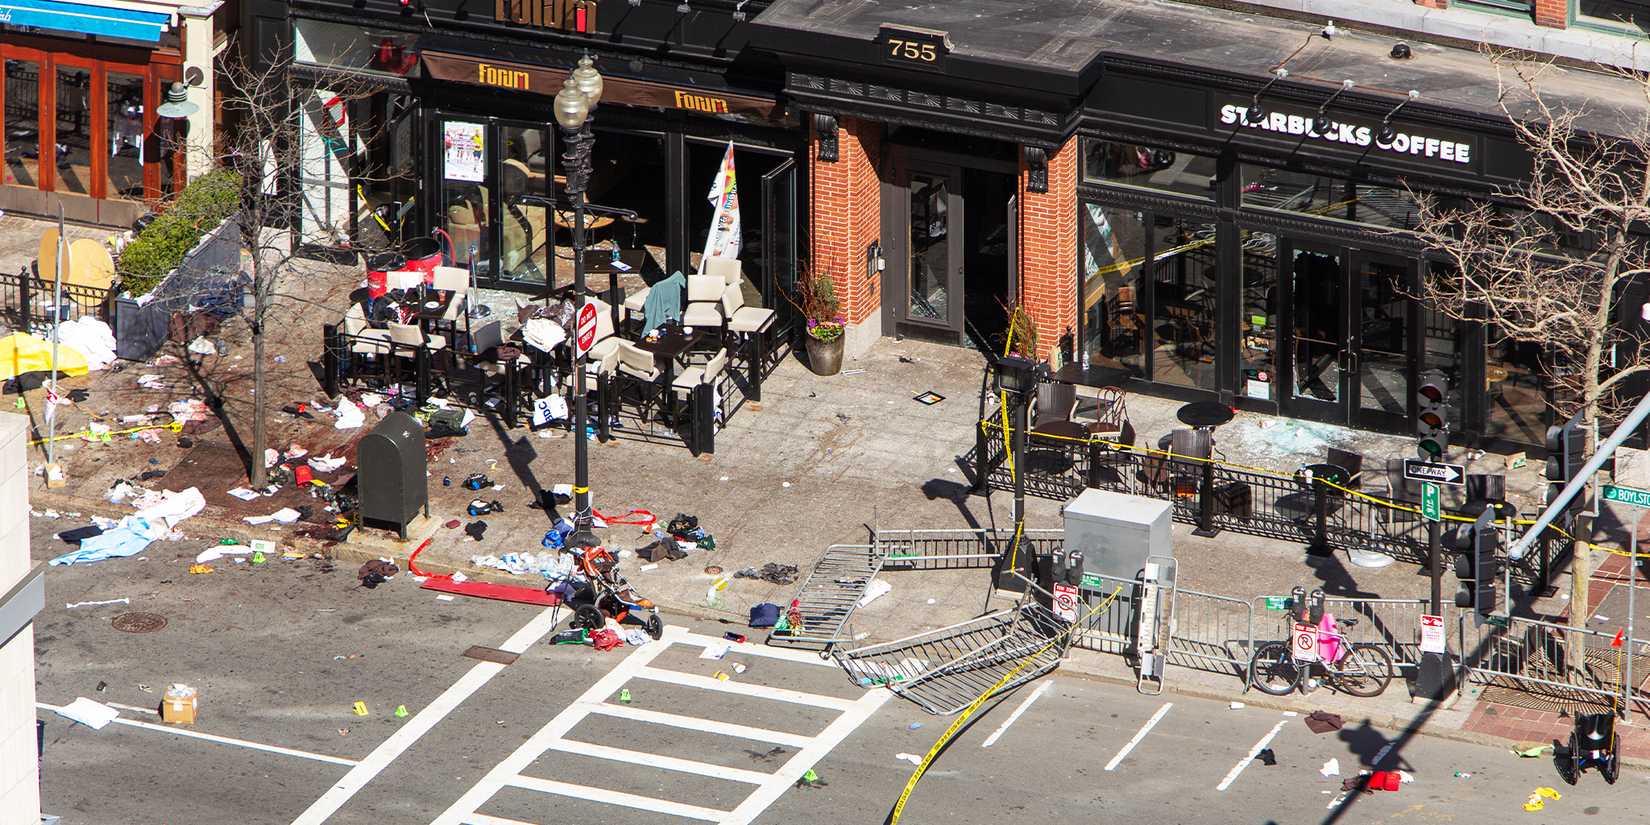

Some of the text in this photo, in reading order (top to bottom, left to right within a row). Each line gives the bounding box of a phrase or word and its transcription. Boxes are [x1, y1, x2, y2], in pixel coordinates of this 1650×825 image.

[888, 39, 936, 61] 755
[479, 63, 529, 90] Forum
[674, 89, 729, 113] Forum
